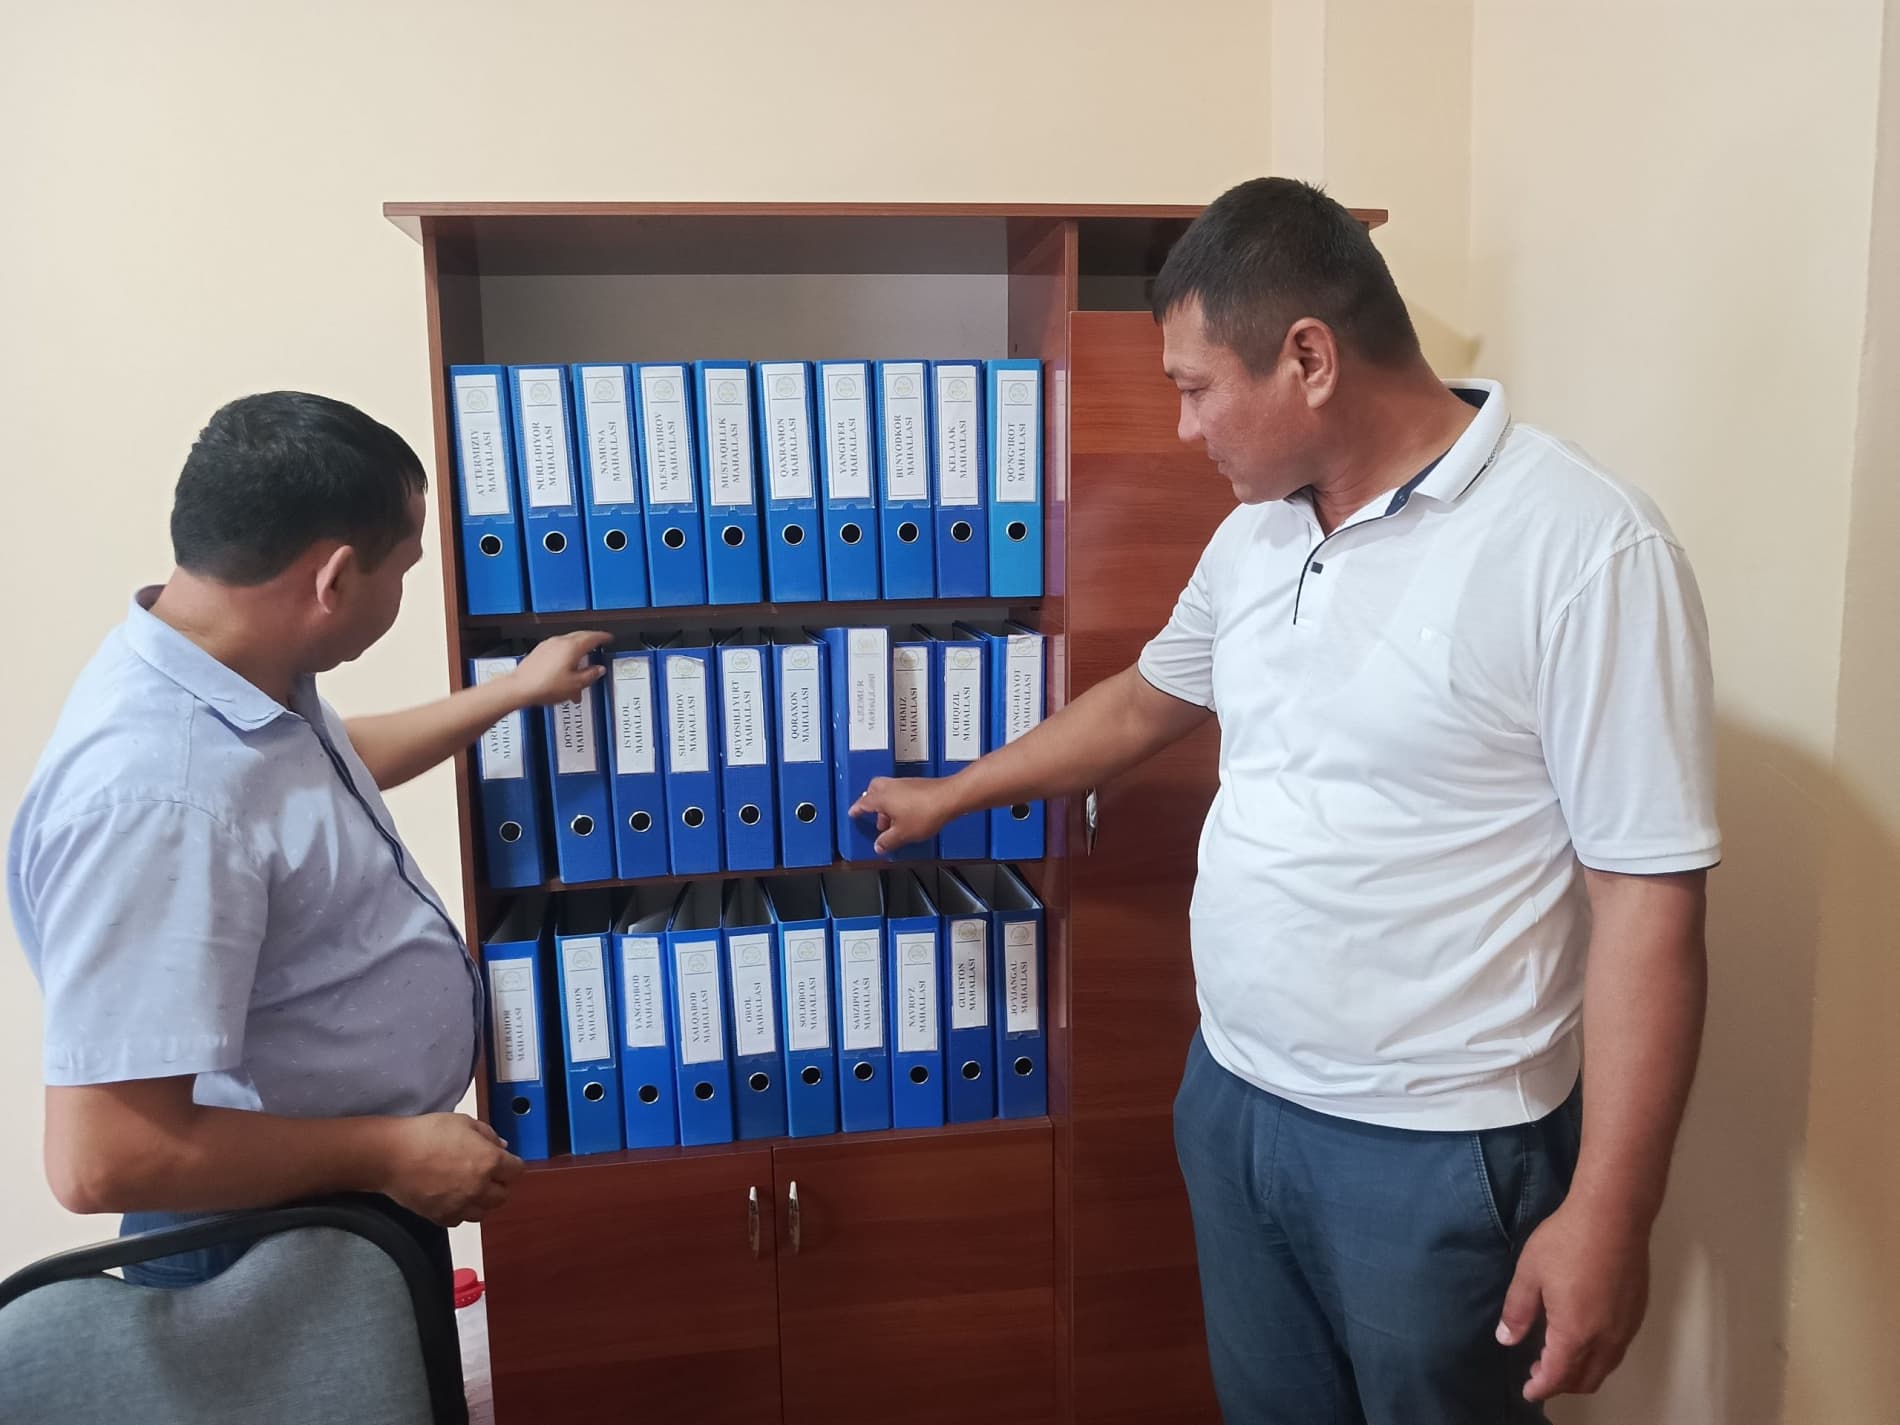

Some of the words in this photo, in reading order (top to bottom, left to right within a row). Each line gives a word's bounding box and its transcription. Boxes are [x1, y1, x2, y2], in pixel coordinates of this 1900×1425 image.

[470, 429, 483, 481] TERMIZIY
[483, 430, 496, 494] MAHALLASI
[530, 421, 545, 491] NURLI-DIYOR
[544, 424, 557, 487] MAHALLASI
[599, 428, 609, 475] NAMUNA
[609, 420, 622, 482] MAHALLASI
[655, 410, 669, 491] M.ESHTEMIROV
[668, 420, 680, 481] MAHALLASI
[719, 416, 732, 489] MUSTAQILLIK
[730, 422, 741, 484] MAHALLASI
[776, 417, 788, 478] QAXRAMON
[787, 416, 800, 478] MAHALLASI
[838, 420, 848, 475] YANGIYER
[848, 416, 859, 478] MAHALLASI
[893, 414, 904, 478] BUNYODKOR
[904, 415, 915, 476] MAHALLASI
[947, 425, 957, 473] KELAJAK
[958, 418, 969, 480] MAHALLASI
[1017, 422, 1027, 482] MAHALLASI
[731, 680, 741, 706] YURT
[741, 689, 753, 747] MAHALLASI
[790, 690, 800, 741] QORAXON
[799, 686, 811, 744] MAHALLASI
[899, 695, 908, 734] TERMIZ
[908, 686, 919, 744] MAHALLASI
[951, 690, 961, 737] UCHQIZIL
[960, 686, 972, 743] MAHALLASI
[1011, 668, 1022, 735] YANGI-HAYOT
[1021, 672, 1033, 730] MAHALLASI
[574, 702, 586, 754] MAHALLA
[622, 702, 632, 749] ISTIQLOL
[631, 696, 643, 754] MAHALLASI
[686, 695, 698, 752] MAHALLASI
[732, 708, 743, 758] QUYOSHLI
[631, 974, 643, 1031] YANGIOBOD
[642, 974, 653, 1030] MAHALLASI
[744, 997, 754, 1023] OROL
[753, 980, 764, 1036] MAHALLASI
[798, 980, 808, 1029] SOLIOBOD
[808, 976, 818, 1031] MAHALLASI
[851, 978, 861, 1031] SABZIPOYA
[862, 976, 872, 1031] MAHALLASI
[917, 979, 927, 1033] MAHALLASI
[957, 961, 967, 1009] GULISTON
[967, 957, 978, 1012] MAHALLASI
[1019, 959, 1030, 1014] MAHALLASI
[502, 1009, 514, 1062] GULBAHOR
[515, 1006, 526, 1062] MAHALLASI
[573, 986, 585, 1043] NURAFSHON
[584, 986, 596, 1042] MAHALLASI
[690, 991, 701, 1043] XALQABOD
[700, 988, 711, 1044] MAHALLASI
